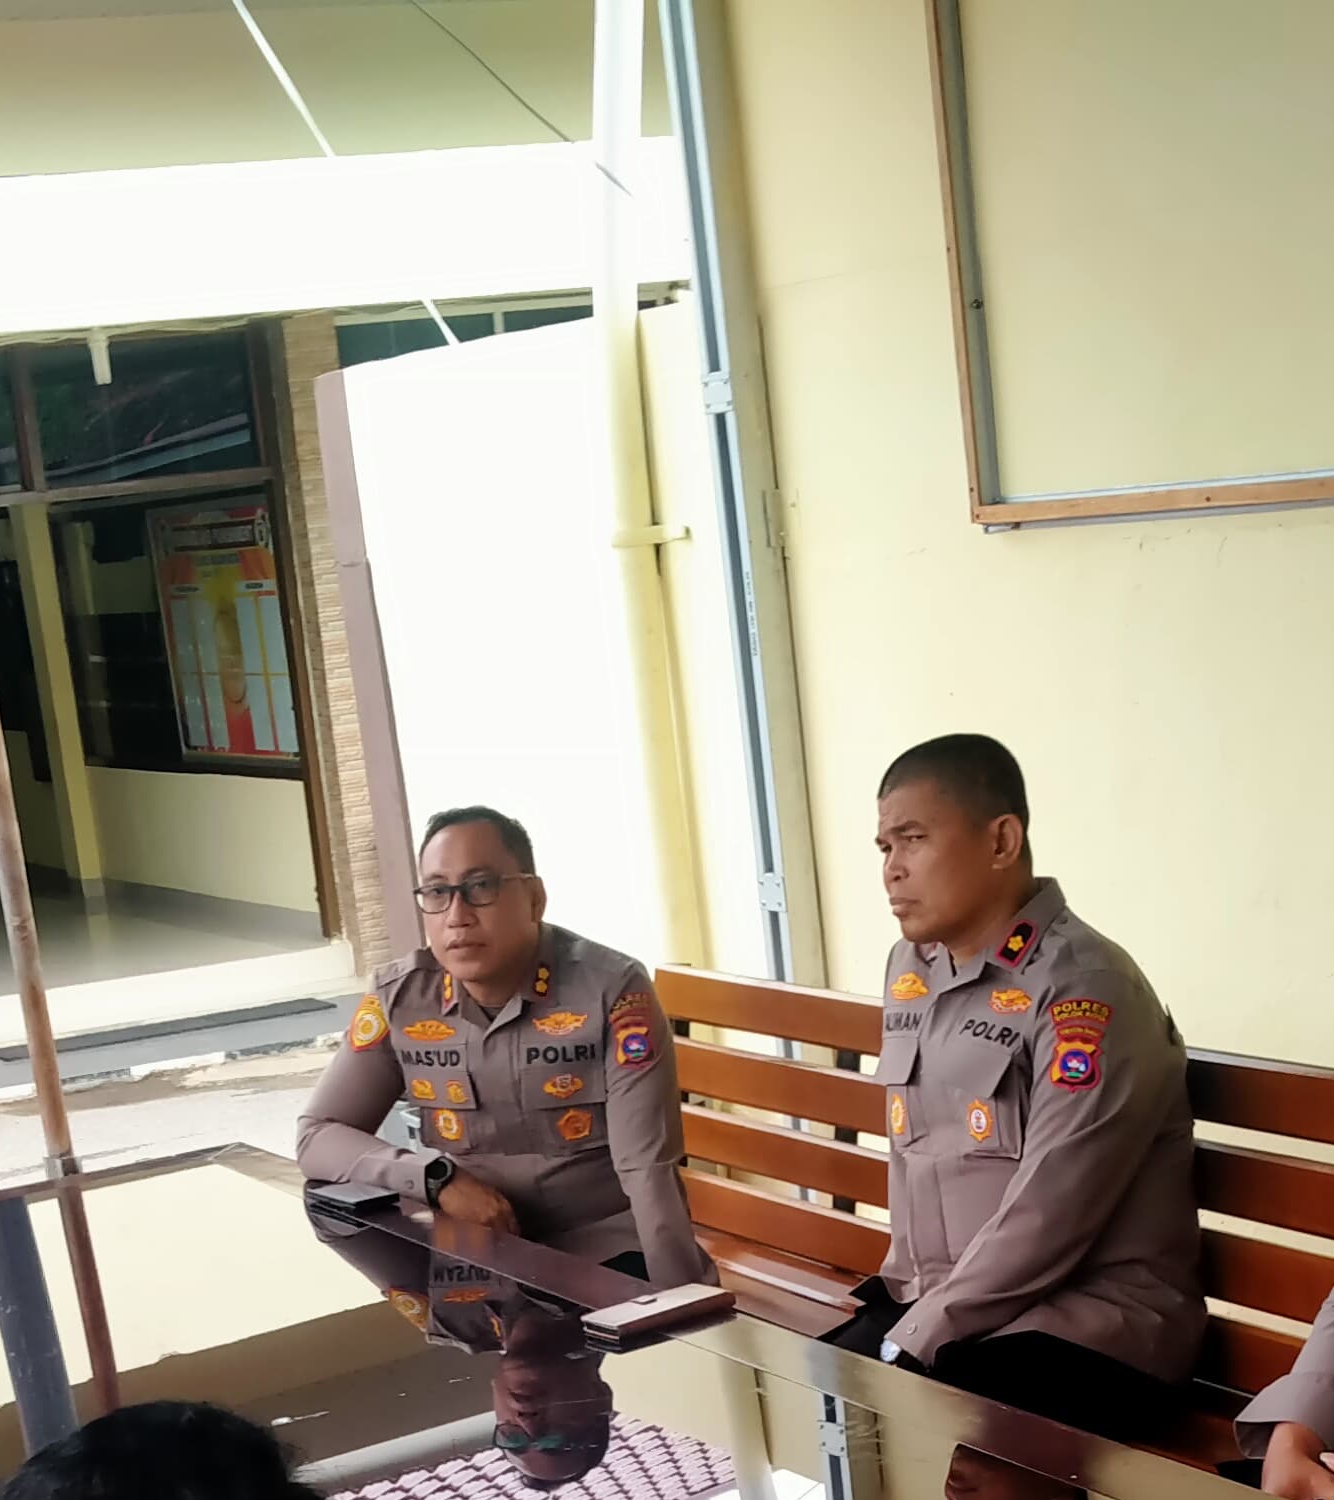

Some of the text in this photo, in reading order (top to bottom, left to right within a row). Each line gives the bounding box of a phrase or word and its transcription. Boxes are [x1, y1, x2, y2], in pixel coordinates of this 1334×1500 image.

[959, 1019, 1020, 1048] POLRI
[401, 1050, 460, 1067] MAS'UD
[526, 1043, 596, 1064] POLRI
